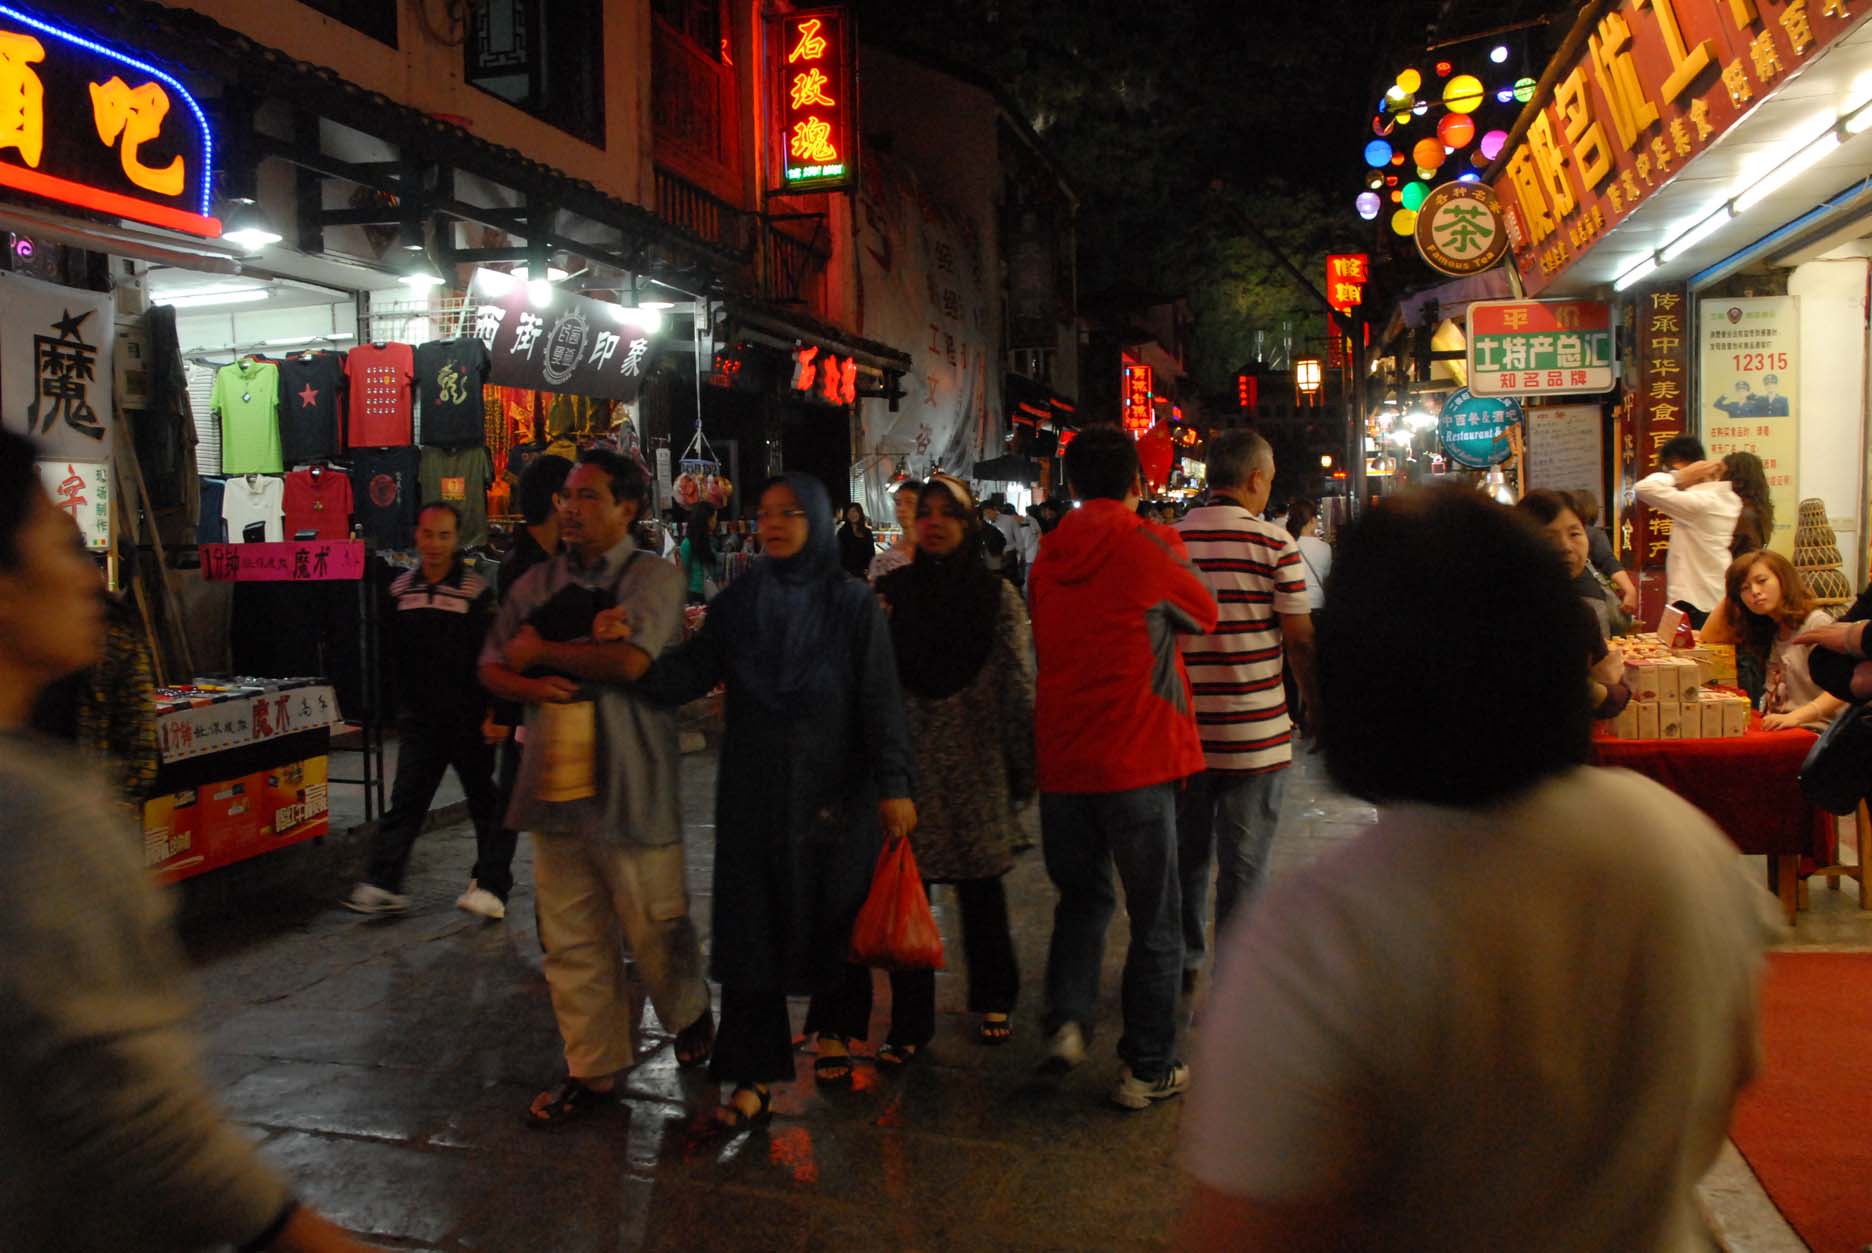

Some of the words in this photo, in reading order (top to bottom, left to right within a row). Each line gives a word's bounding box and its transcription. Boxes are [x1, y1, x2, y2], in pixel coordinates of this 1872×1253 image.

[788, 18, 837, 162] 石玫瑰
[1434, 204, 1493, 252] 茶
[1473, 251, 1495, 267] Tea
[1503, 305, 1580, 331] 平价
[474, 304, 543, 361] 西街
[588, 330, 649, 377] 印象
[1475, 332, 1609, 372] 土特产总汇
[27, 308, 106, 441] 魔
[1733, 352, 1788, 372] 12315
[1499, 370, 1587, 389] 知名品牌
[1446, 428, 1493, 442] Restaurant
